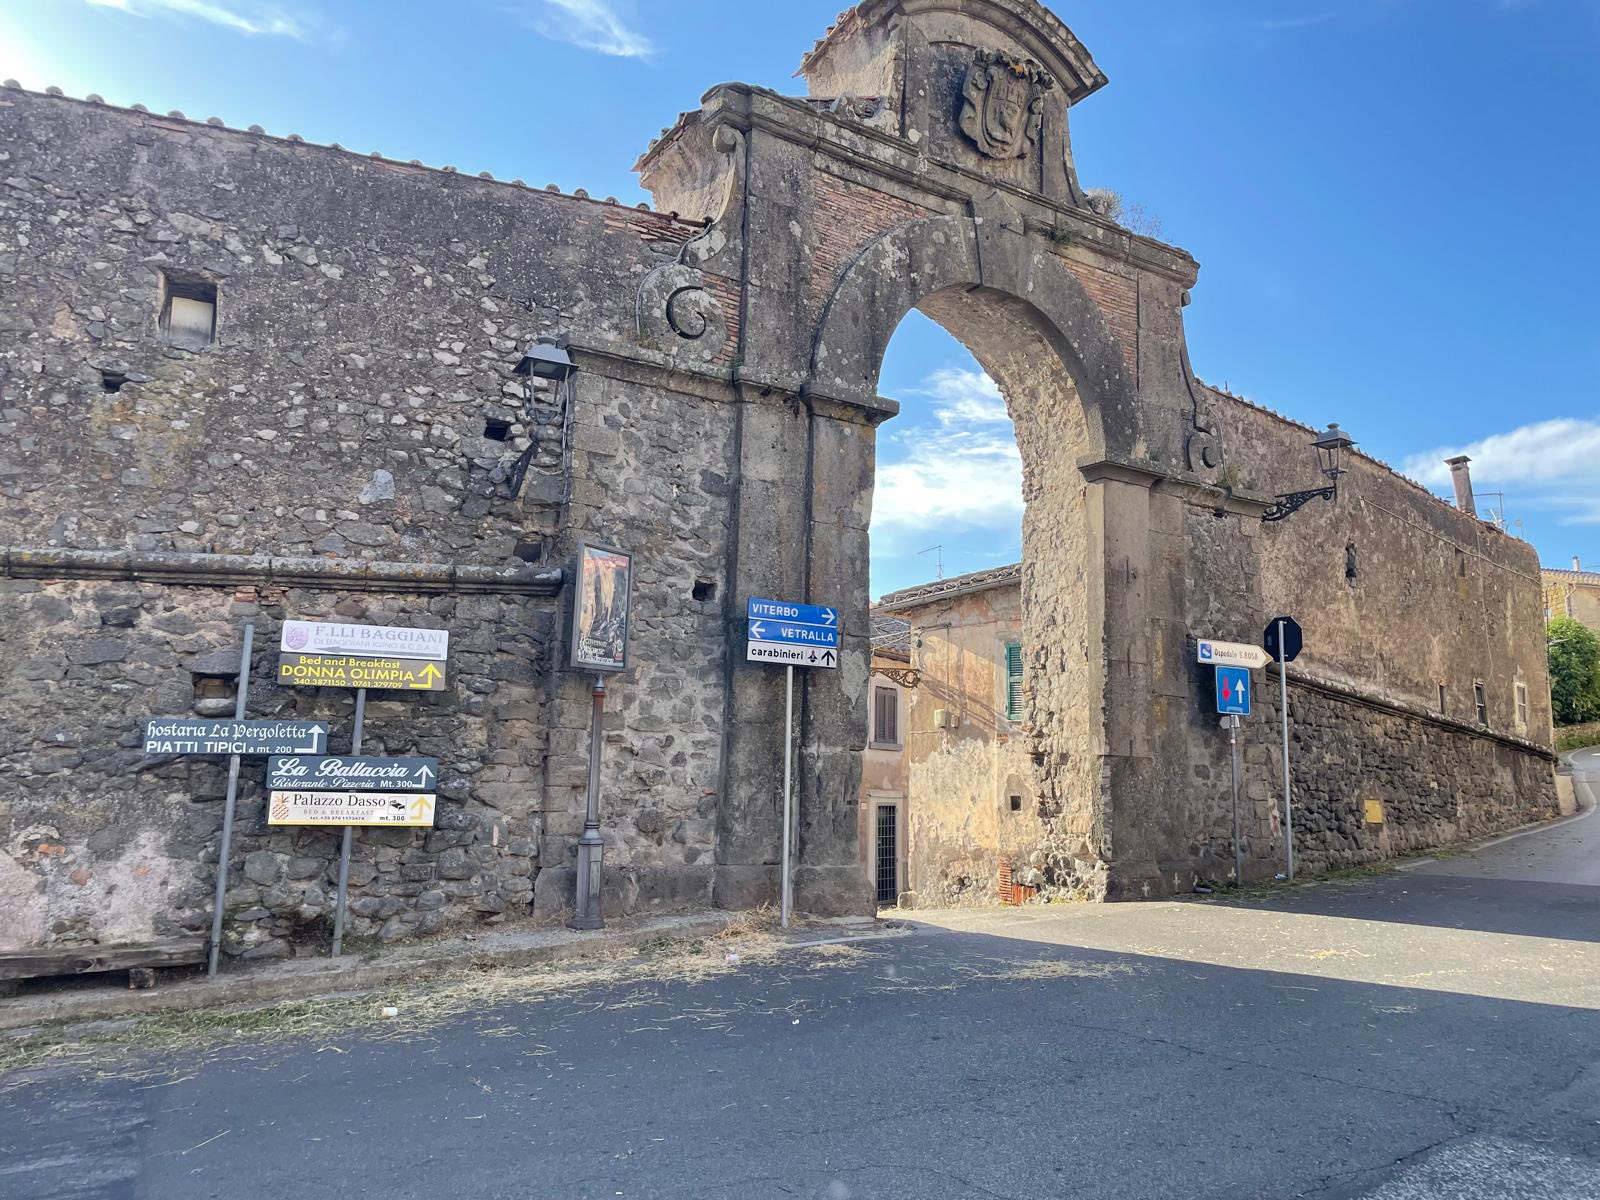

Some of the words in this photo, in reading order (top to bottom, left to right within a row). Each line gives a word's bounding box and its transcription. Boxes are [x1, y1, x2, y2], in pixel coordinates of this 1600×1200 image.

[752, 603, 799, 617] VITERBO
[360, 628, 443, 644] BAGGIANI
[781, 627, 834, 642] VETRALLA
[751, 648, 804, 660] carabinieri
[299, 655, 322, 666] Bed
[323, 657, 346, 667] and
[348, 658, 401, 669] Breakfast
[281, 664, 346, 679] DONNA
[349, 668, 415, 681] OLIMPIA
[209, 723, 230, 738] La
[232, 723, 307, 741] Pergoletta
[146, 741, 198, 753] PIATTI
[204, 741, 247, 753] TIPICI
[275, 745, 292, 753] 200
[271, 757, 310, 777] La
[314, 759, 410, 778] Ballaccia
[270, 777, 328, 788] Ristorante
[329, 778, 377, 788] Pizzeria
[292, 793, 343, 806] Palazzo
[347, 795, 387, 807] Dasso
